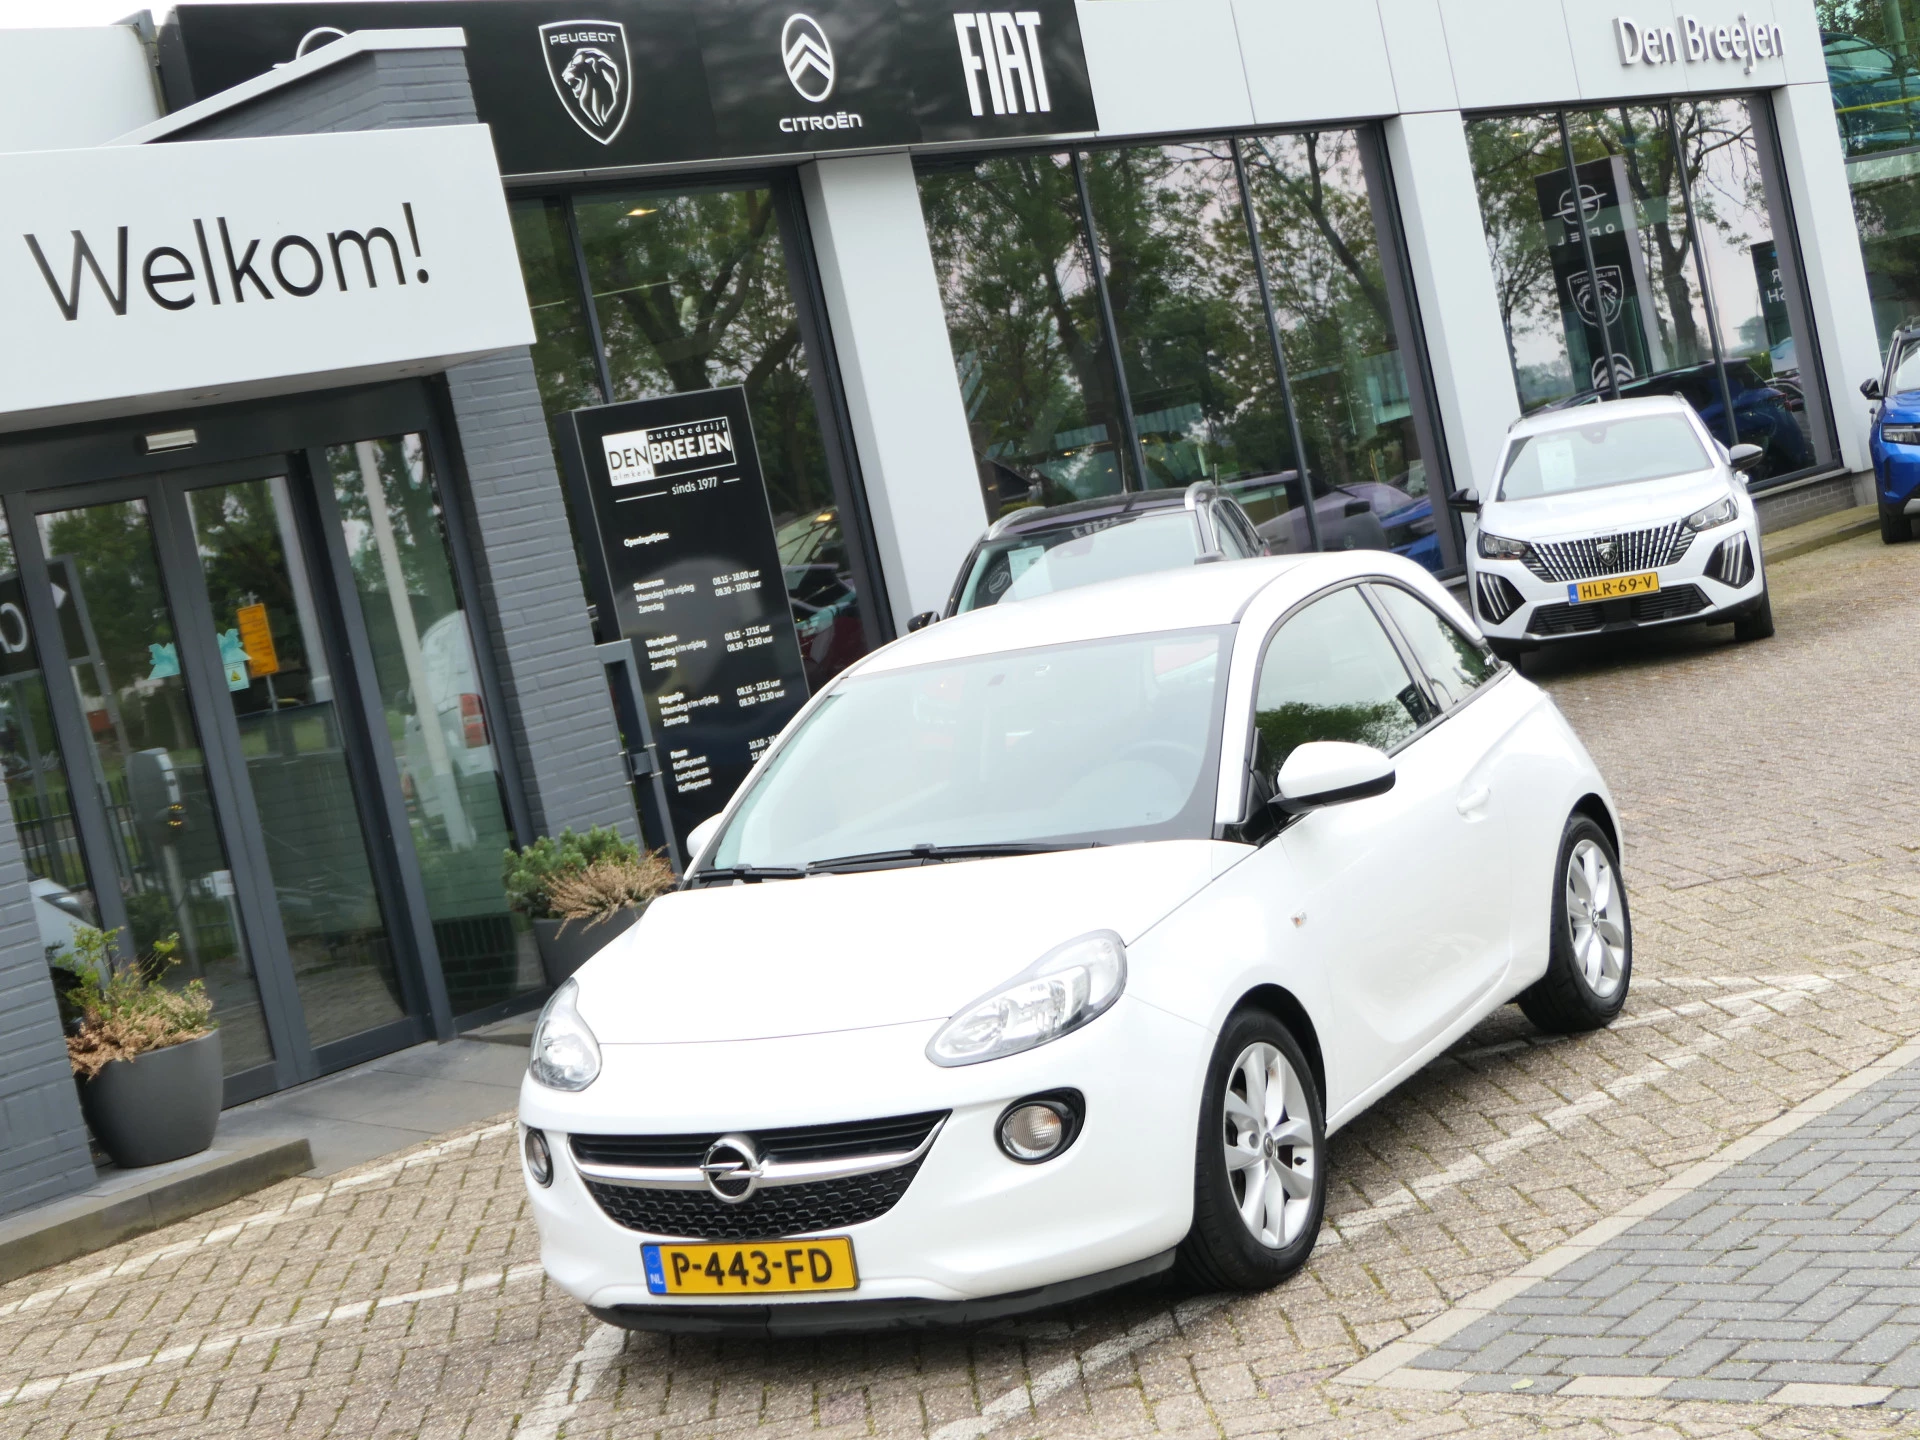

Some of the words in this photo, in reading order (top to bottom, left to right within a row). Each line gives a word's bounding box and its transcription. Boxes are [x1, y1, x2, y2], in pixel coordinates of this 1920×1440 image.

[550, 31, 616, 46] PEUGEOT
[1612, 16, 1677, 66] Den
[1677, 12, 1784, 75] Breejen
[953, 11, 1050, 116] FIAT
[23, 202, 430, 321] Welkom!
[648, 420, 727, 441] autobedrijf
[613, 468, 652, 481] almkerk
[671, 482, 696, 495] sinds
[697, 476, 718, 491] 1977
[749, 570, 759, 578] uur
[751, 581, 762, 589] uur
[1582, 575, 1652, 598] HLR-69-V
[759, 625, 770, 633] uur
[762, 635, 773, 644] uur
[775, 690, 785, 698] uur
[671, 1247, 833, 1287] P-443-FD
[650, 1272, 664, 1285] NL
